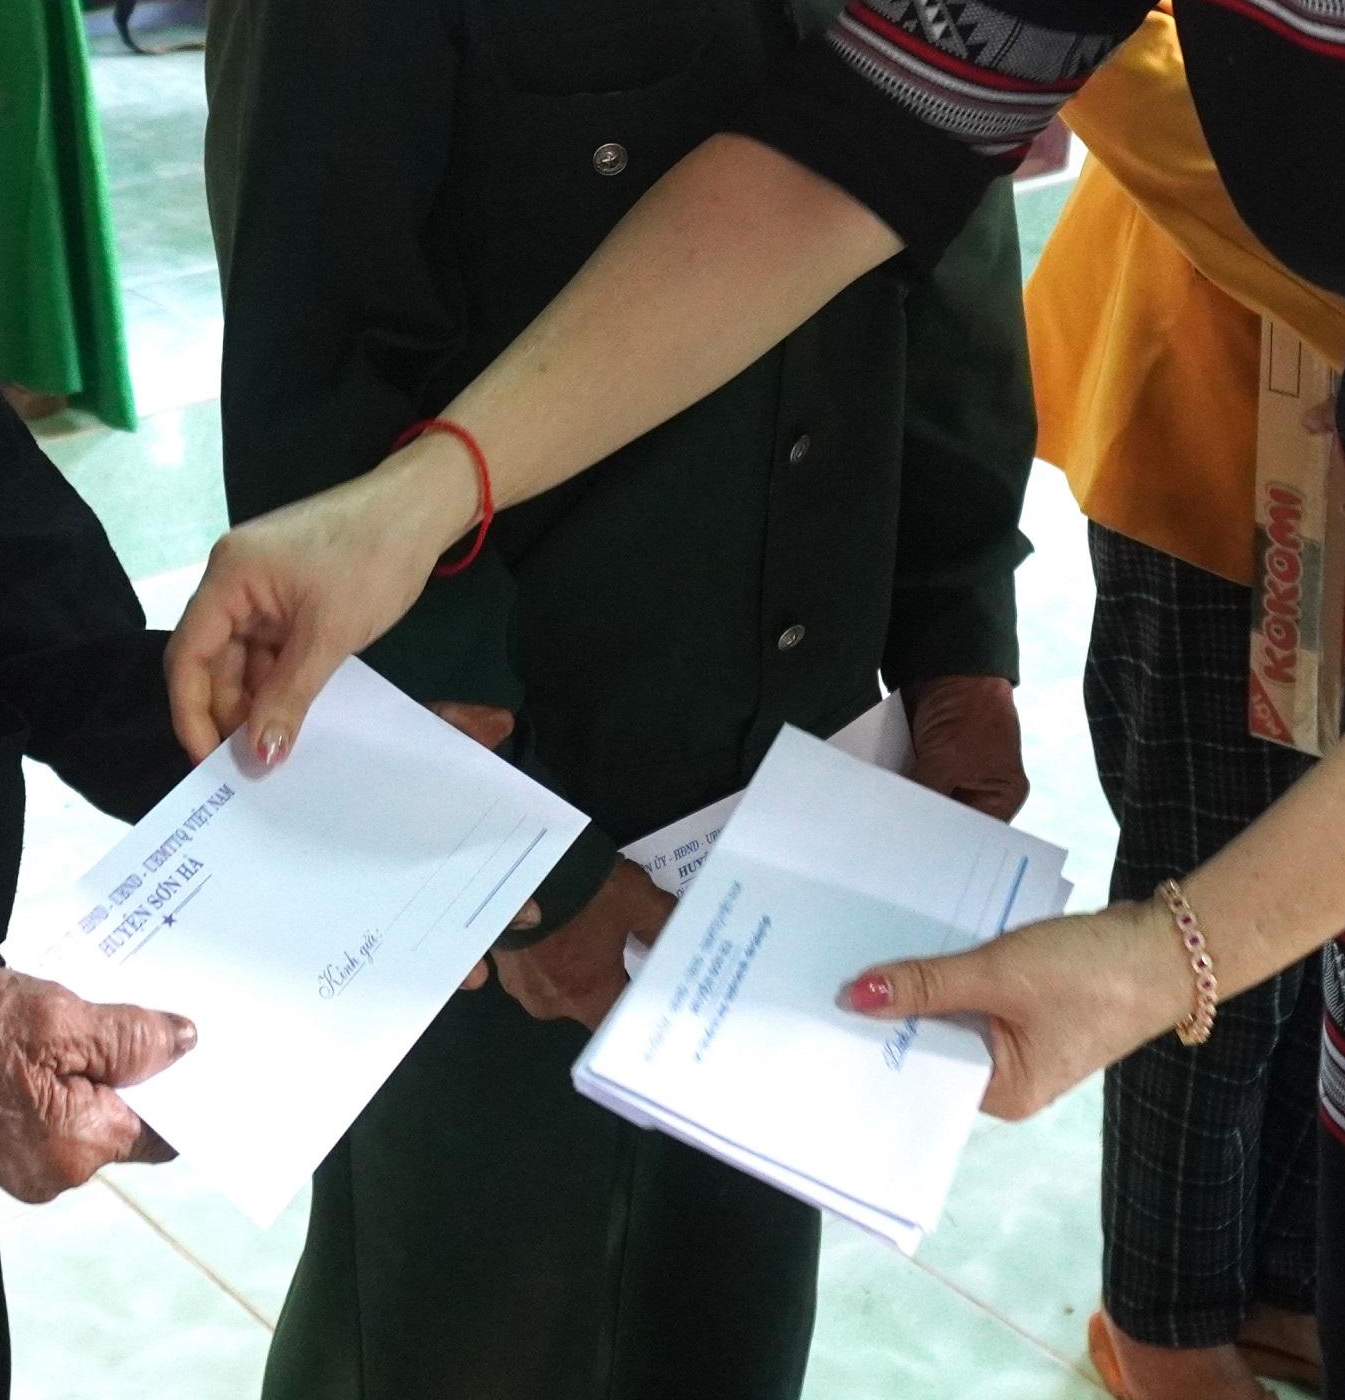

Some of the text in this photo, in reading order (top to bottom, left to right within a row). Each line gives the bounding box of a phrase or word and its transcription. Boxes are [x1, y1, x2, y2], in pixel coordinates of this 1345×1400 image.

[1262, 484, 1305, 685] KOKOMI
[182, 805, 214, 833] VIỆT
[206, 783, 236, 811] NAM
[98, 904, 152, 958] HUYỆN
[147, 875, 183, 910] SƠN
[176, 854, 204, 882] HÀ
